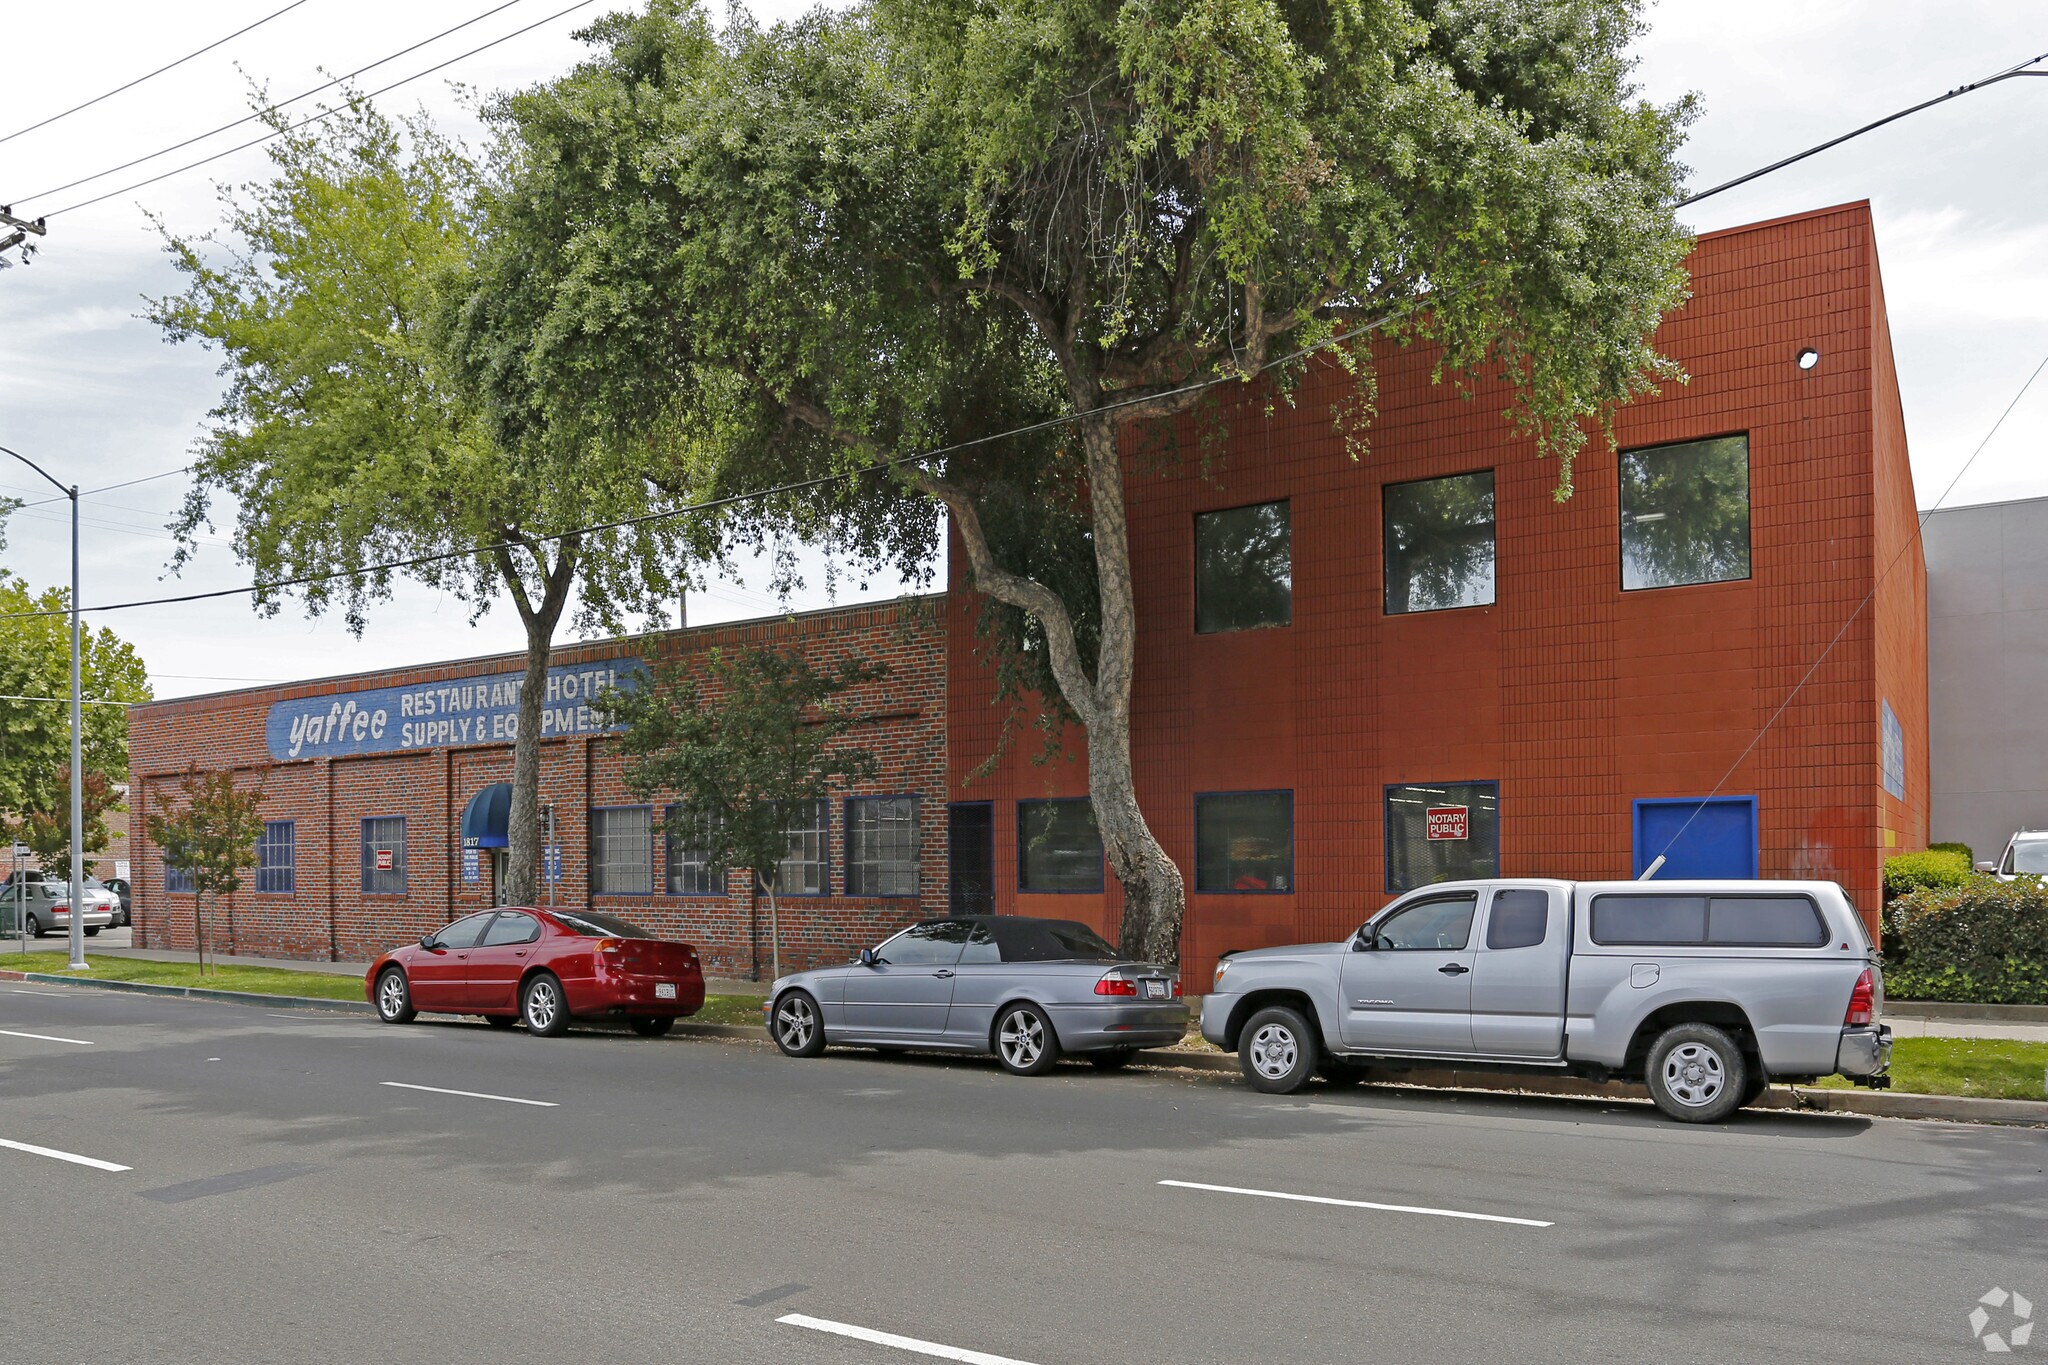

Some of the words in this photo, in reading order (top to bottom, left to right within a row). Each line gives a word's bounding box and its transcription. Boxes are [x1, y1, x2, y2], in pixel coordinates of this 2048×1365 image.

[288, 700, 387, 757] yaffee
[401, 718, 471, 747] SUPPLY
[476, 716, 486, 741] &
[1428, 813, 1466, 824] NOTARY
[1430, 823, 1465, 834] PUBLIC
[463, 837, 480, 847] 1817
